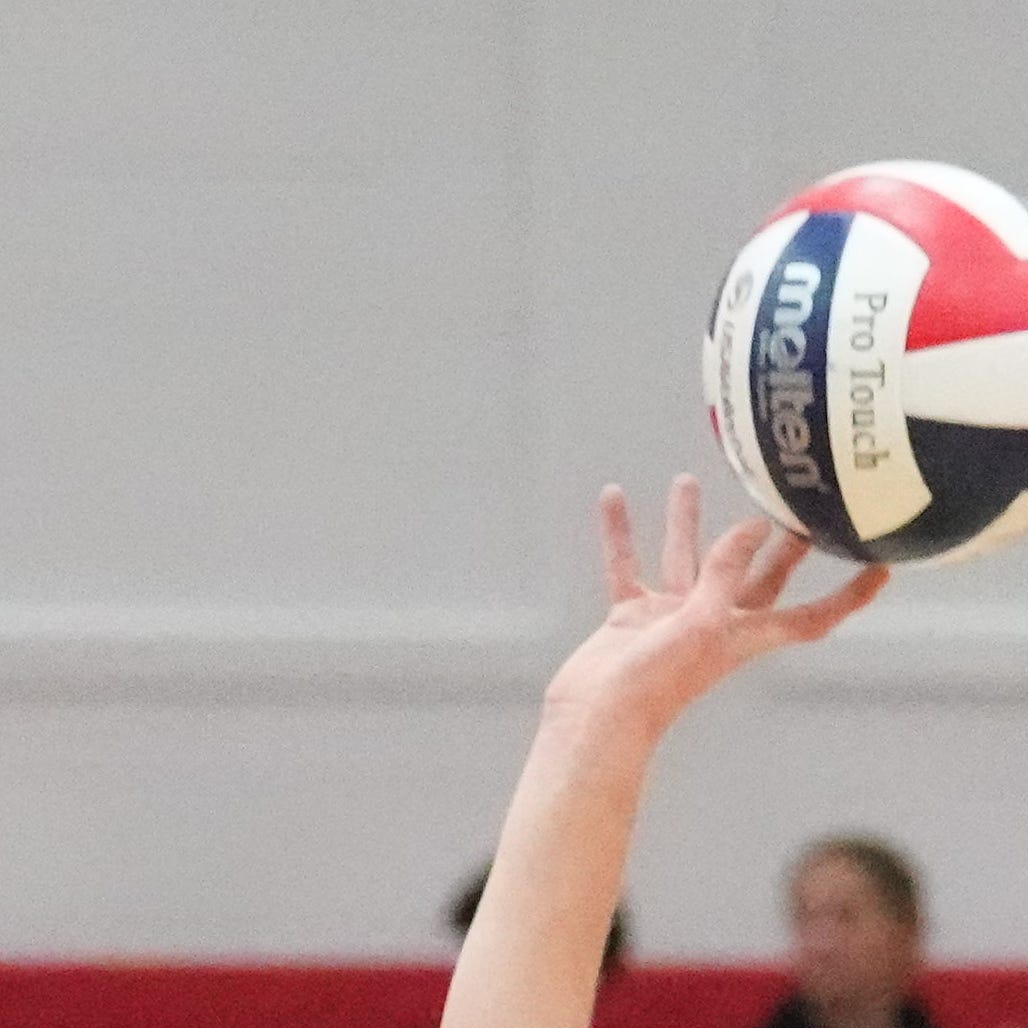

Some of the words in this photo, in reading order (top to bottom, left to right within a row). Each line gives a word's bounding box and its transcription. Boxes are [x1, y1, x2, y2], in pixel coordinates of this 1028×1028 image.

[769, 260, 825, 491] molten
[850, 291, 887, 351] Pro
[849, 361, 890, 470] Touch
